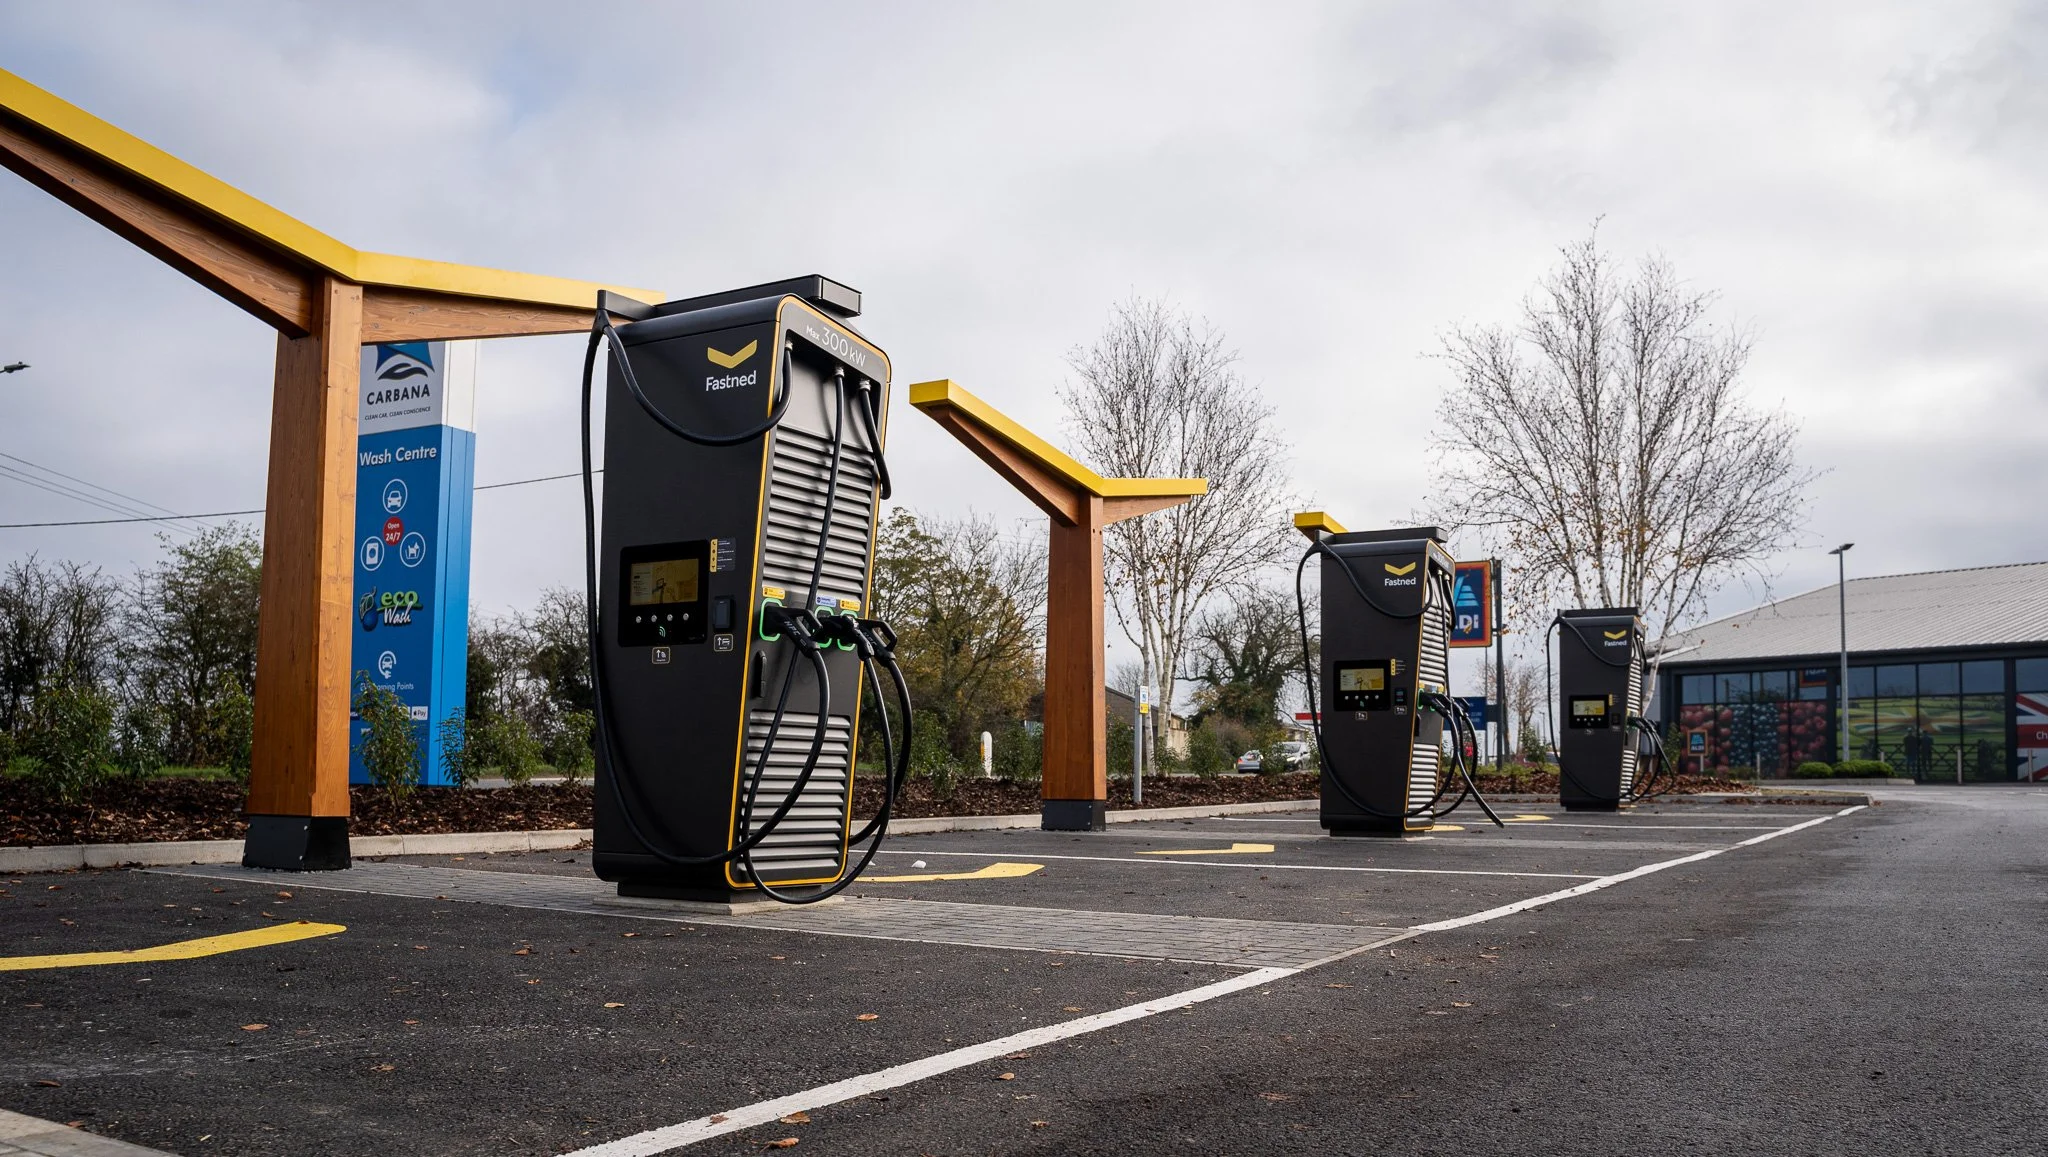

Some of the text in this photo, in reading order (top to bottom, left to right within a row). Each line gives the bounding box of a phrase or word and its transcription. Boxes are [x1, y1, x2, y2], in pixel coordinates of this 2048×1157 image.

[806, 325, 866, 367] Max 300 kW
[706, 371, 756, 392] Fastned
[366, 384, 430, 405] CARBANA
[365, 413, 378, 421] CLEAN
[404, 406, 431, 415] CONSCIENCE
[360, 446, 437, 466] Wash Centre
[387, 522, 400, 530] Open
[385, 532, 401, 542] 24/7
[1384, 577, 1417, 586] Fastned
[381, 590, 418, 606] eco
[384, 601, 413, 624] Wash
[397, 682, 414, 690] Points
[417, 709, 427, 717] Pay
